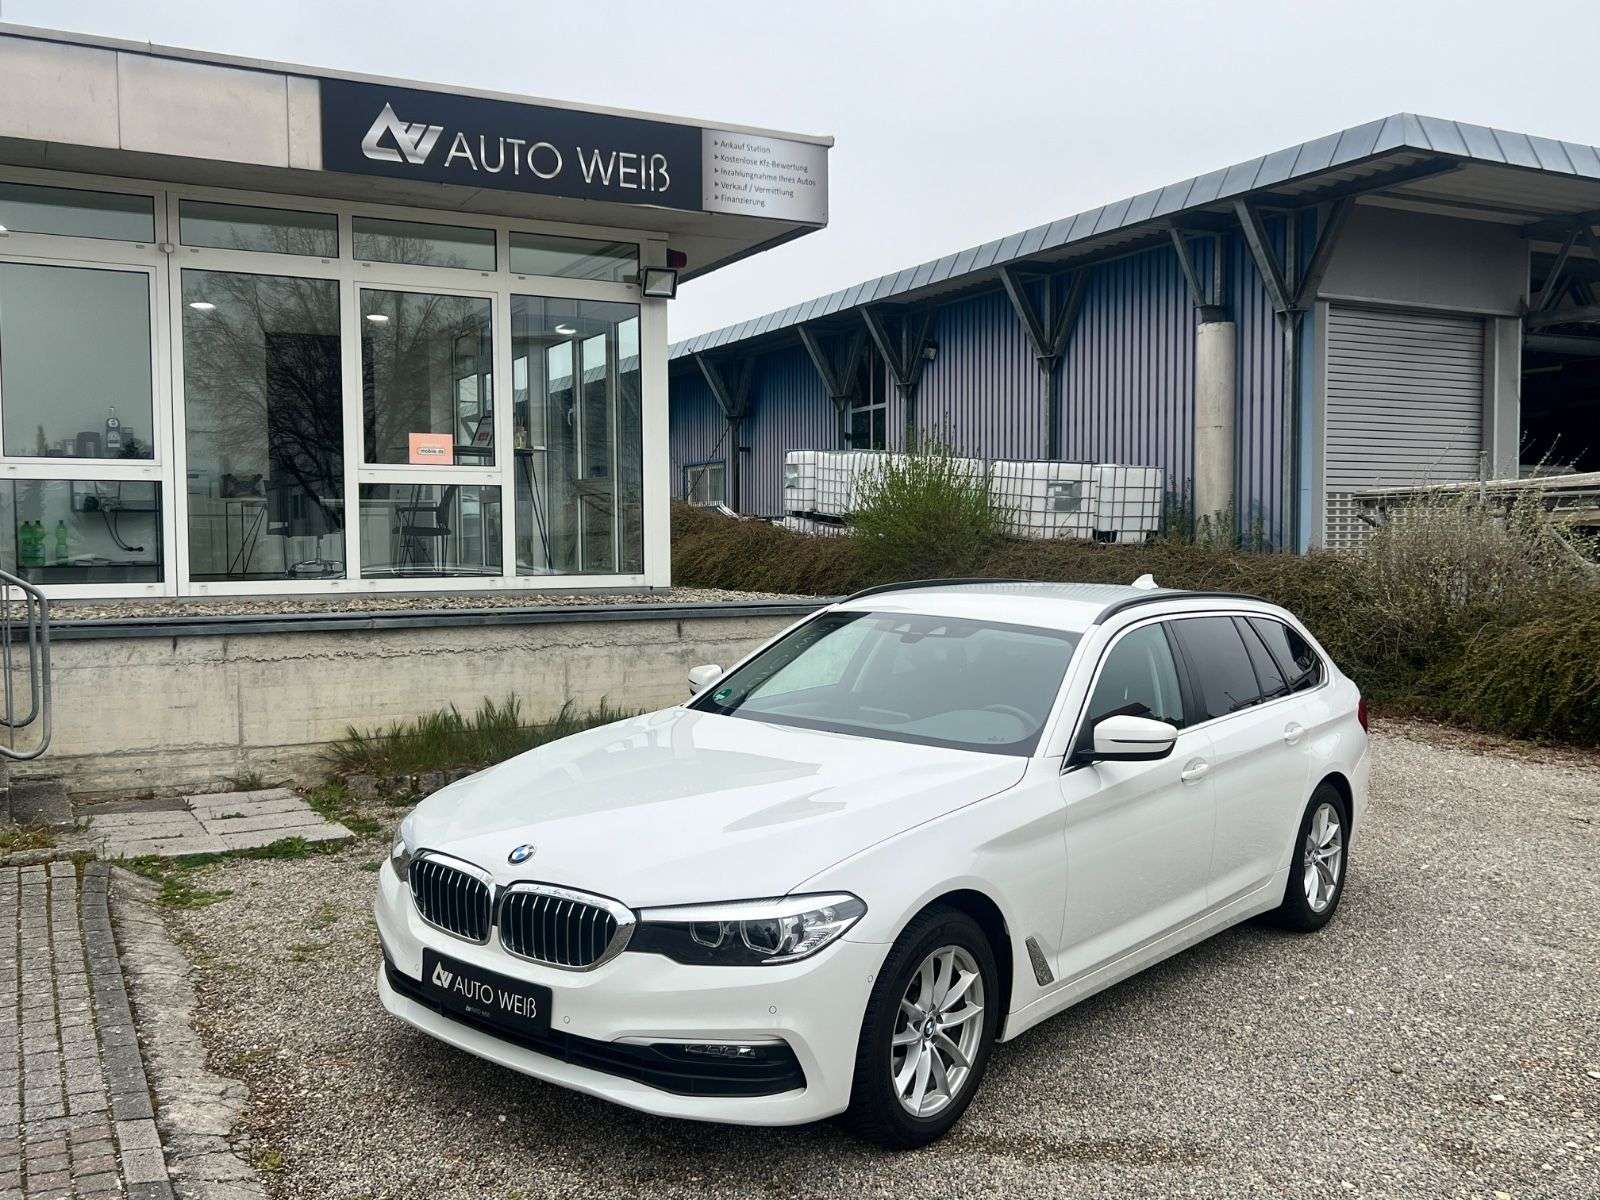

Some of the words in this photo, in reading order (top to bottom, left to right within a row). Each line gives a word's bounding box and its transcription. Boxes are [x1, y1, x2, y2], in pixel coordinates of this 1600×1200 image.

[444, 132, 563, 179] AUTO
[720, 141, 745, 150] Ankauf
[747, 144, 771, 153] Station
[720, 155, 758, 166] Kostenlose
[720, 168, 777, 181] Inzahlungnahme
[779, 176, 795, 184] Ihres
[797, 178, 816, 187] Autos
[720, 181, 748, 191] Verkauf
[754, 186, 794, 198] Vermittlung
[721, 194, 766, 208] Finanzierung
[453, 976, 494, 1004] AUTO
